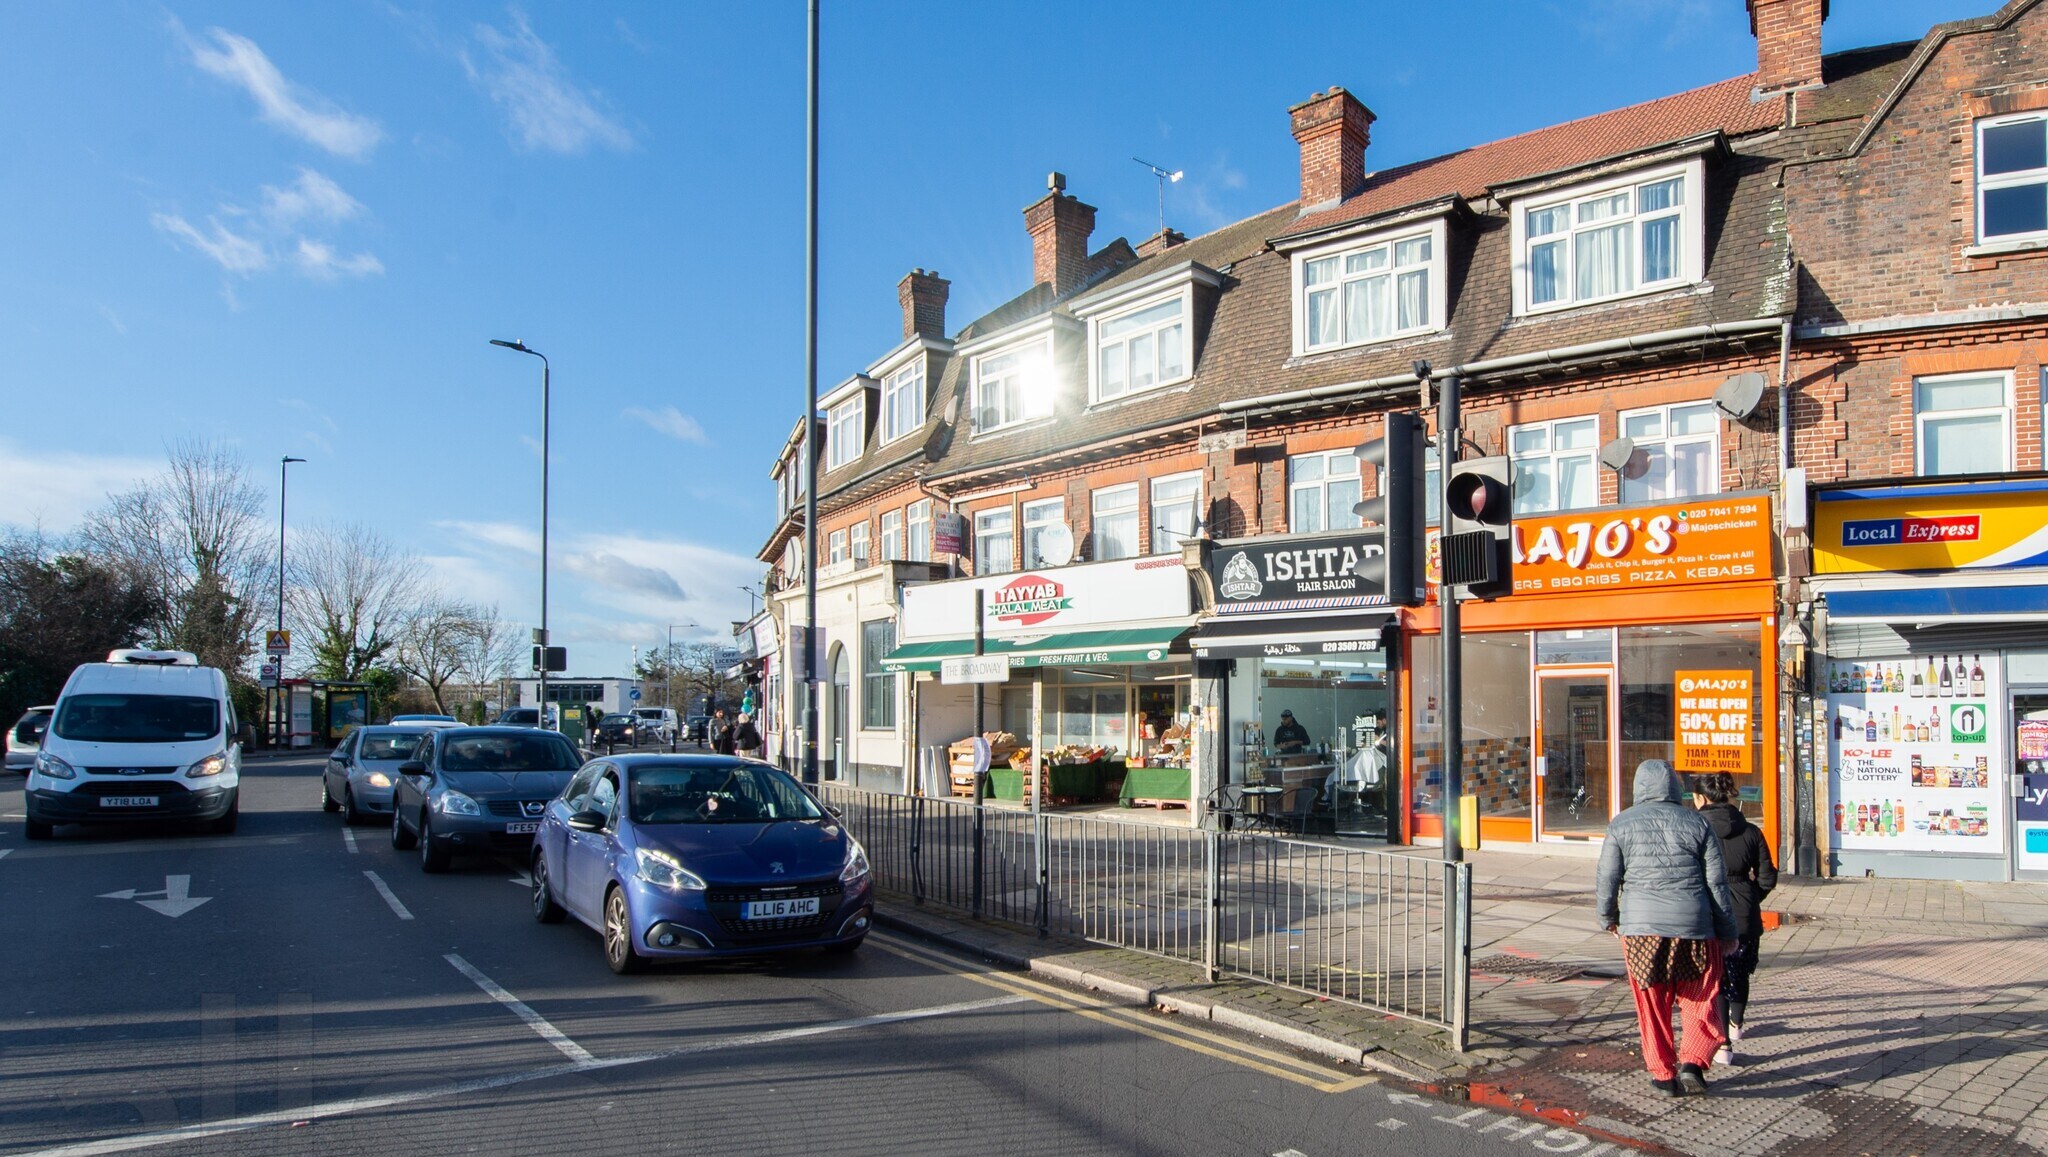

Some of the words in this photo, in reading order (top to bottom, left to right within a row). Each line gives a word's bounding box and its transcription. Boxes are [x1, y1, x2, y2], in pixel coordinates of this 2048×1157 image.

[1690, 509, 1707, 519] 020
[1709, 507, 1731, 517] 7041
[1734, 504, 1757, 514] 7594
[1690, 519, 1757, 533] Majoschicken
[1848, 524, 1896, 541] Local
[1907, 524, 1976, 542] Express
[1512, 515, 1675, 568] AJO'S
[1615, 559, 1631, 569] Chip
[1641, 557, 1666, 568] Burger
[1677, 554, 1696, 563] Pizza
[1697, 553, 1703, 562] it
[1709, 551, 1731, 561] Crave
[1732, 551, 1739, 560] it
[1551, 576, 1583, 588] BBQ
[1585, 573, 1621, 585] RIBS
[1630, 570, 1677, 583] PIZZA
[1686, 564, 1755, 579] KEBABS
[997, 583, 1058, 603] TAYYAB
[1227, 582, 1256, 593] ISHTAR
[1296, 581, 1322, 593] HAIR
[1322, 579, 1356, 591] SALON
[993, 604, 1029, 616] HALAL
[1031, 599, 1064, 612] MEAT
[1322, 642, 1337, 652] 020
[1337, 641, 1357, 651] 3509
[1358, 640, 1377, 650] 7269
[1039, 654, 1063, 664] FRESH
[1063, 653, 1085, 664] FRUIT
[1085, 654, 1091, 663] &
[1092, 652, 1110, 662] VEG.
[945, 665, 958, 677] THE
[960, 662, 1003, 676] BROADWAY
[1694, 678, 1748, 691] MAJO'S
[1679, 697, 1697, 710] WE
[1698, 697, 1718, 710] ARE
[1719, 697, 1748, 710] OPEN
[1679, 712, 1716, 731] 50%
[1718, 713, 1748, 731] OFF
[1681, 732, 1709, 746] THIS
[1710, 733, 1746, 746] WEEK
[1952, 733, 1985, 743] top-up
[1686, 748, 1709, 758] 11AM
[1717, 749, 1741, 759] 11PM
[1685, 759, 1689, 767] 7
[1690, 759, 1710, 768] DAYS
[1711, 759, 1717, 768] A
[1719, 760, 1742, 769] WEEK
[1857, 766, 1903, 774] NATIONAL
[1857, 774, 1898, 782] LOTTERY
[2024, 785, 2048, 806] Ly
[513, 823, 540, 832] FE57
[752, 901, 784, 917] LL16
[787, 899, 814, 915] AHC
